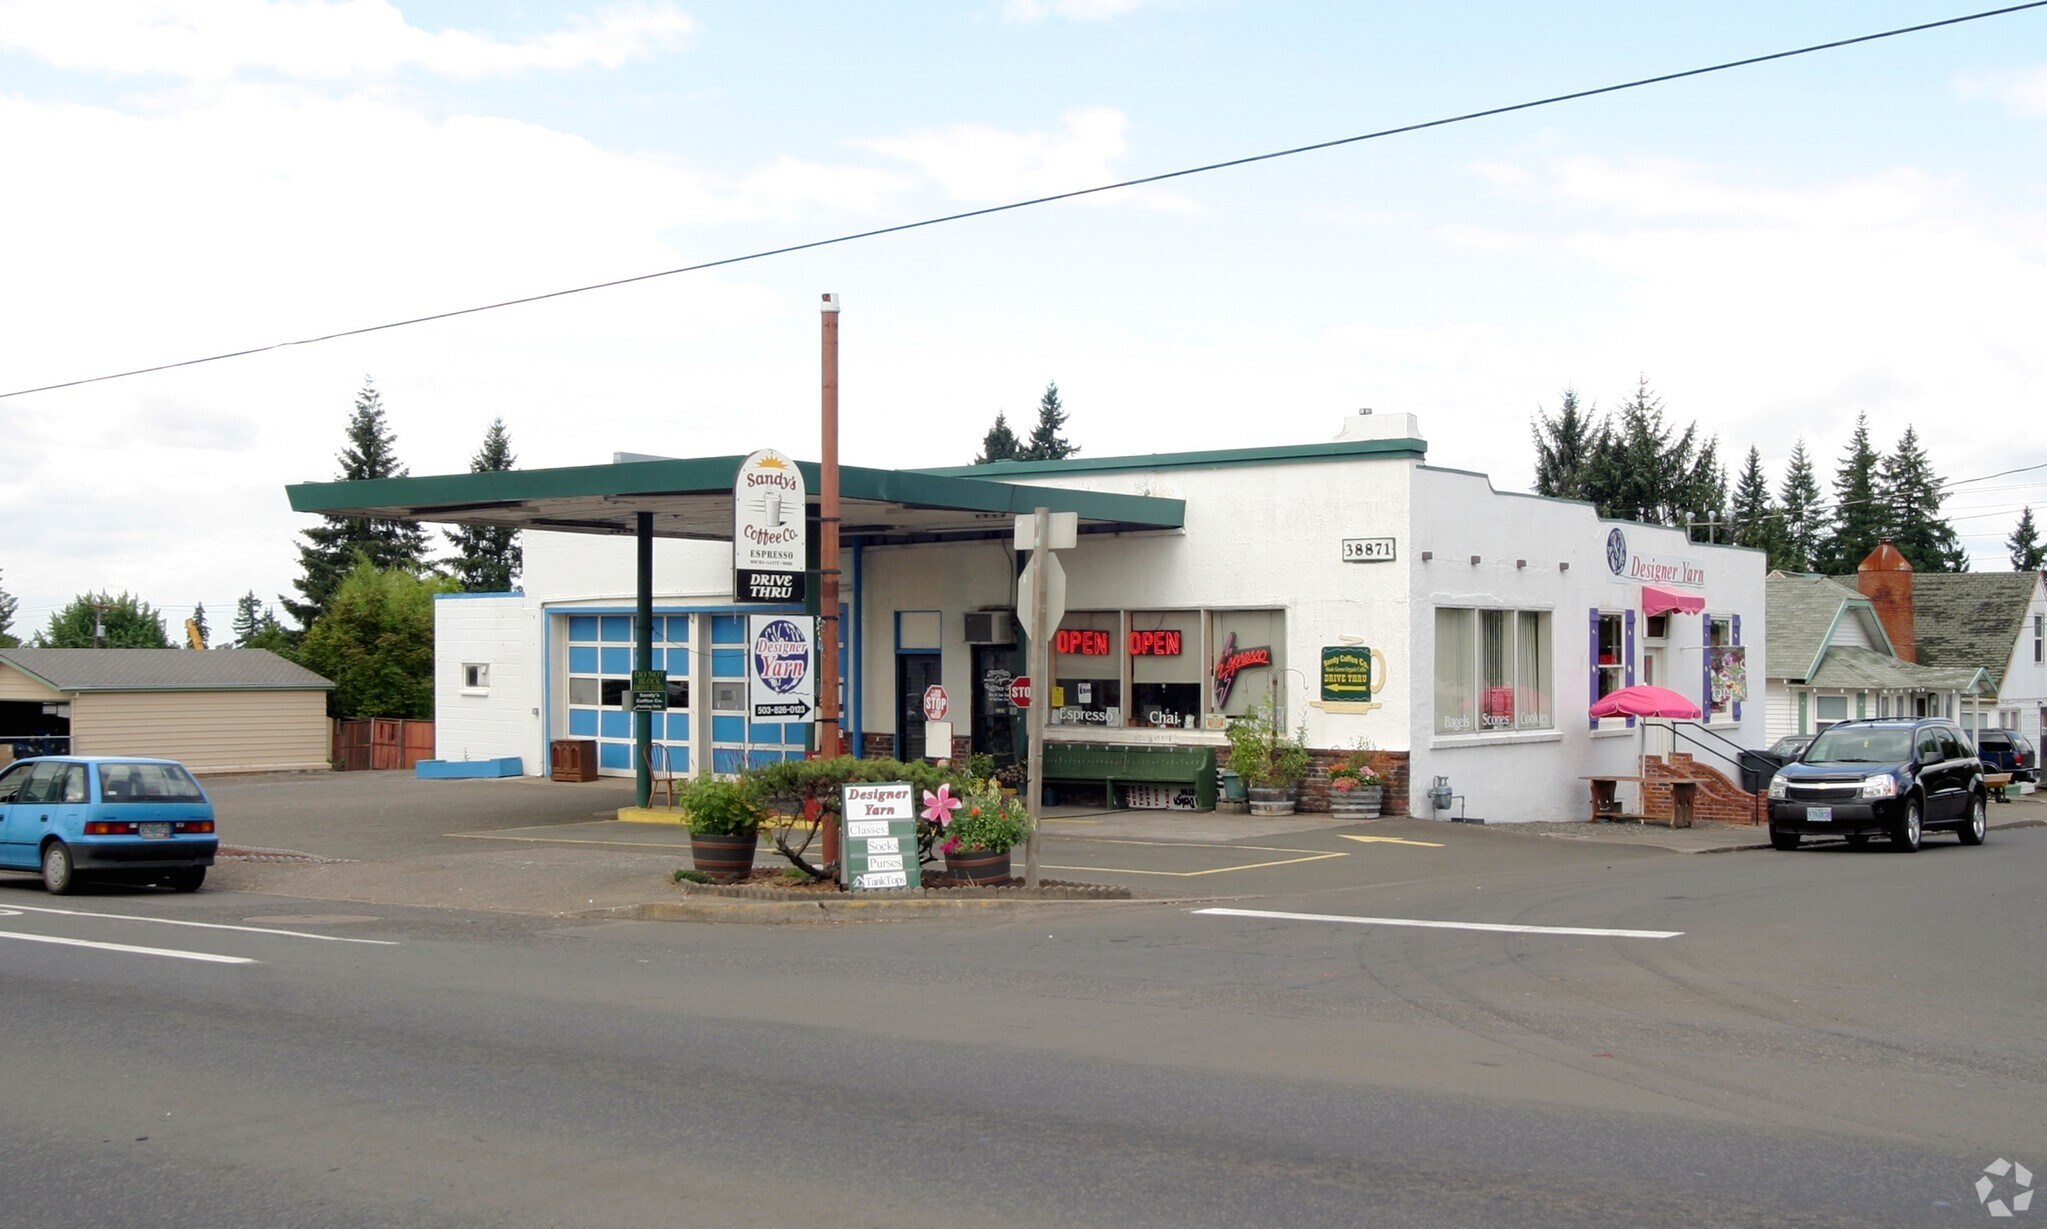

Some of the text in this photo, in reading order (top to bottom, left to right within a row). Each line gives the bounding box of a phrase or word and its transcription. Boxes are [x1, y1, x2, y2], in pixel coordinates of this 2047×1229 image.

[747, 472, 796, 490] Sandy's
[744, 524, 798, 546] Coffee Co.
[750, 549, 794, 560] ESPRESSO
[1345, 543, 1391, 556] 38871
[1631, 555, 1704, 584] Designer Yarn
[750, 573, 793, 586] DRIVE
[750, 585, 793, 598] THRU
[758, 638, 808, 655] Designer
[1056, 630, 1108, 655] OPEN
[1129, 631, 1181, 655] OPEN
[763, 655, 804, 677] Yarn
[1340, 654, 1359, 665] Coffee
[1324, 674, 1368, 682] DRIVE THRU
[1012, 686, 1031, 698] STO
[925, 697, 947, 710] STOP
[1060, 707, 1113, 723] Espresso
[1482, 713, 1509, 726] Scones
[1520, 711, 1550, 724] Cookies
[1444, 715, 1470, 731] Bagels
[848, 788, 909, 802] Designer
[864, 804, 895, 816] Yarn
[849, 825, 889, 835] Classes:
[868, 841, 899, 851] Socks
[869, 858, 902, 868] Purses
